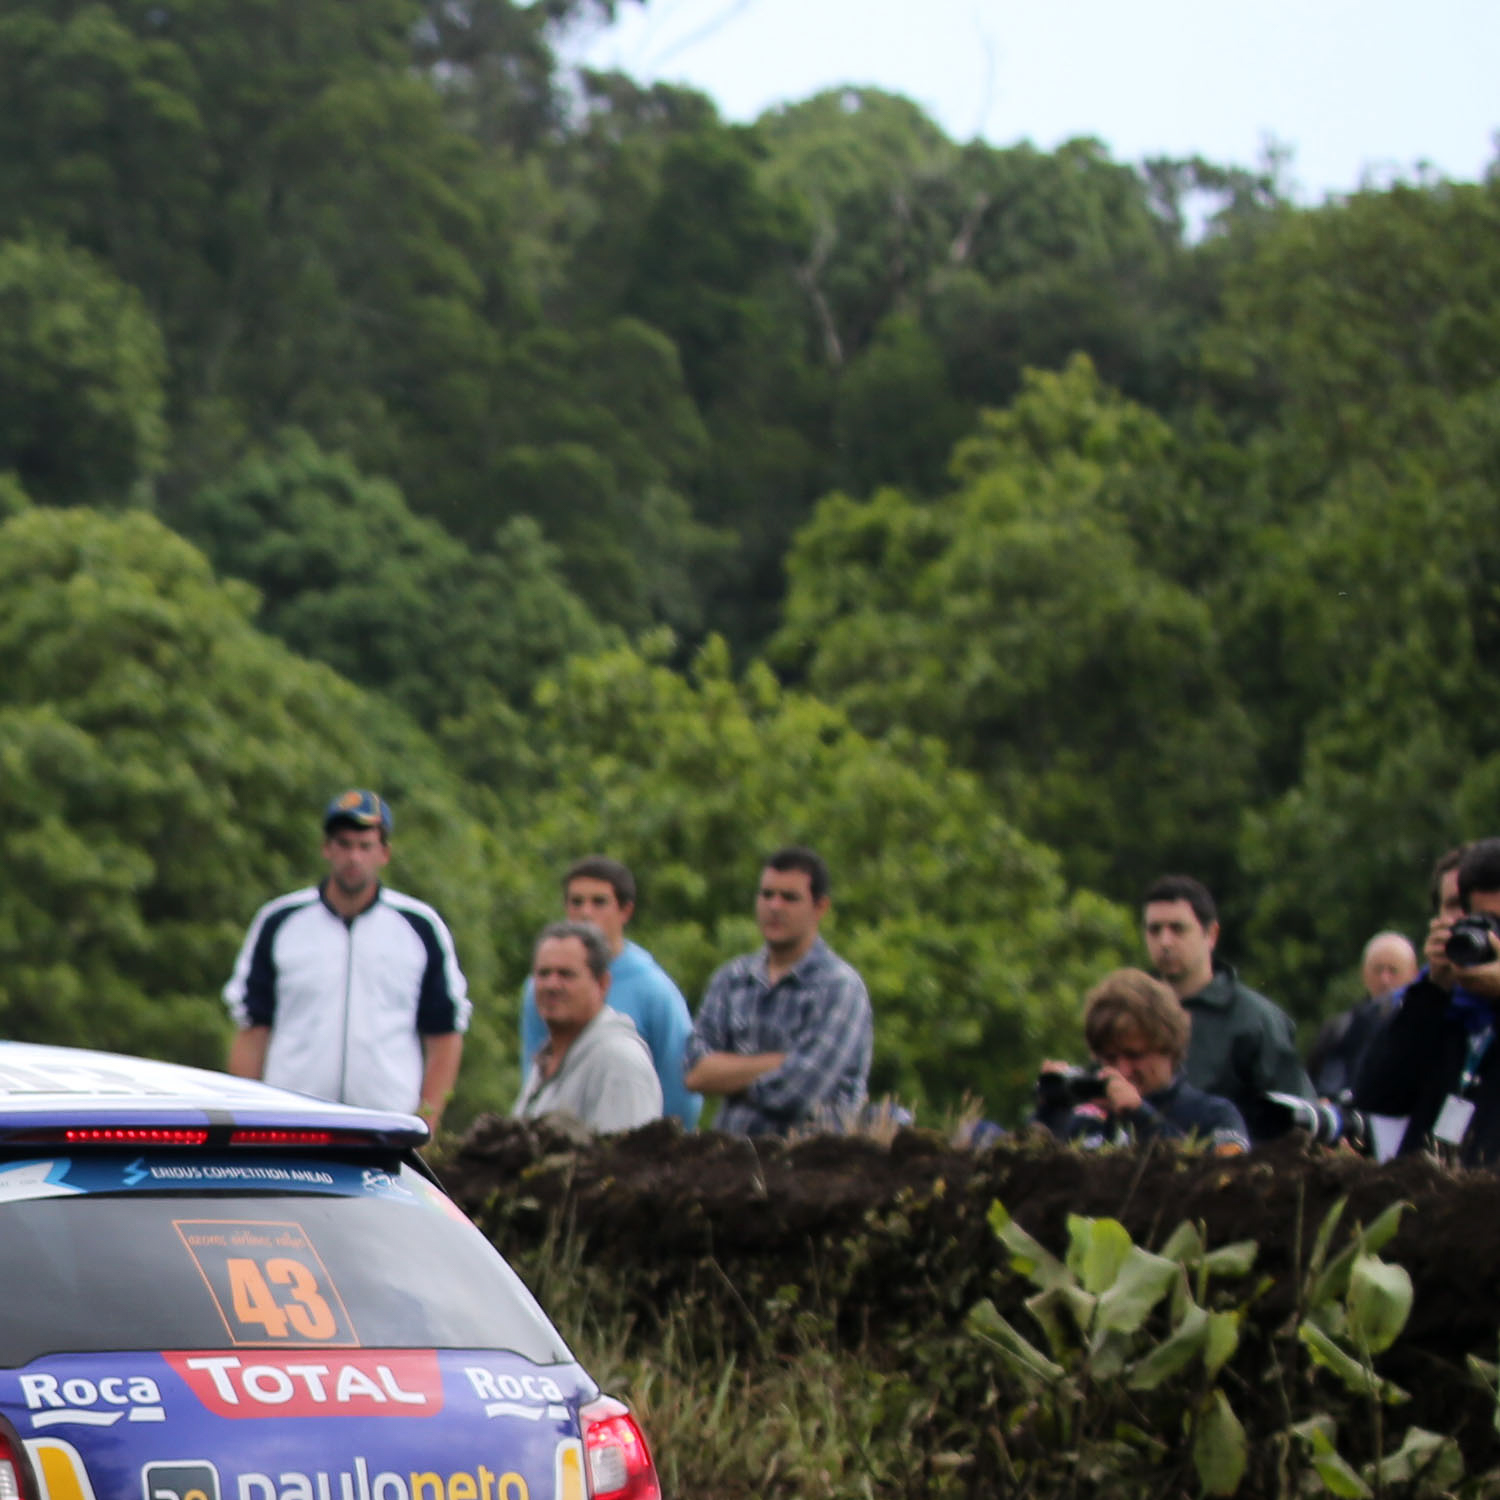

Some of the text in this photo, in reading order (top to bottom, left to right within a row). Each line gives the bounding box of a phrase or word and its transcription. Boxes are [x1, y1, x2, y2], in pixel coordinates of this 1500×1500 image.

[202, 1166, 290, 1181] COMPETITION
[291, 1169, 334, 1185] AHEAD
[227, 1257, 338, 1340] 43
[18, 1373, 162, 1410] Roca
[186, 1356, 427, 1405] TOTAL
[463, 1367, 564, 1401] Roca
